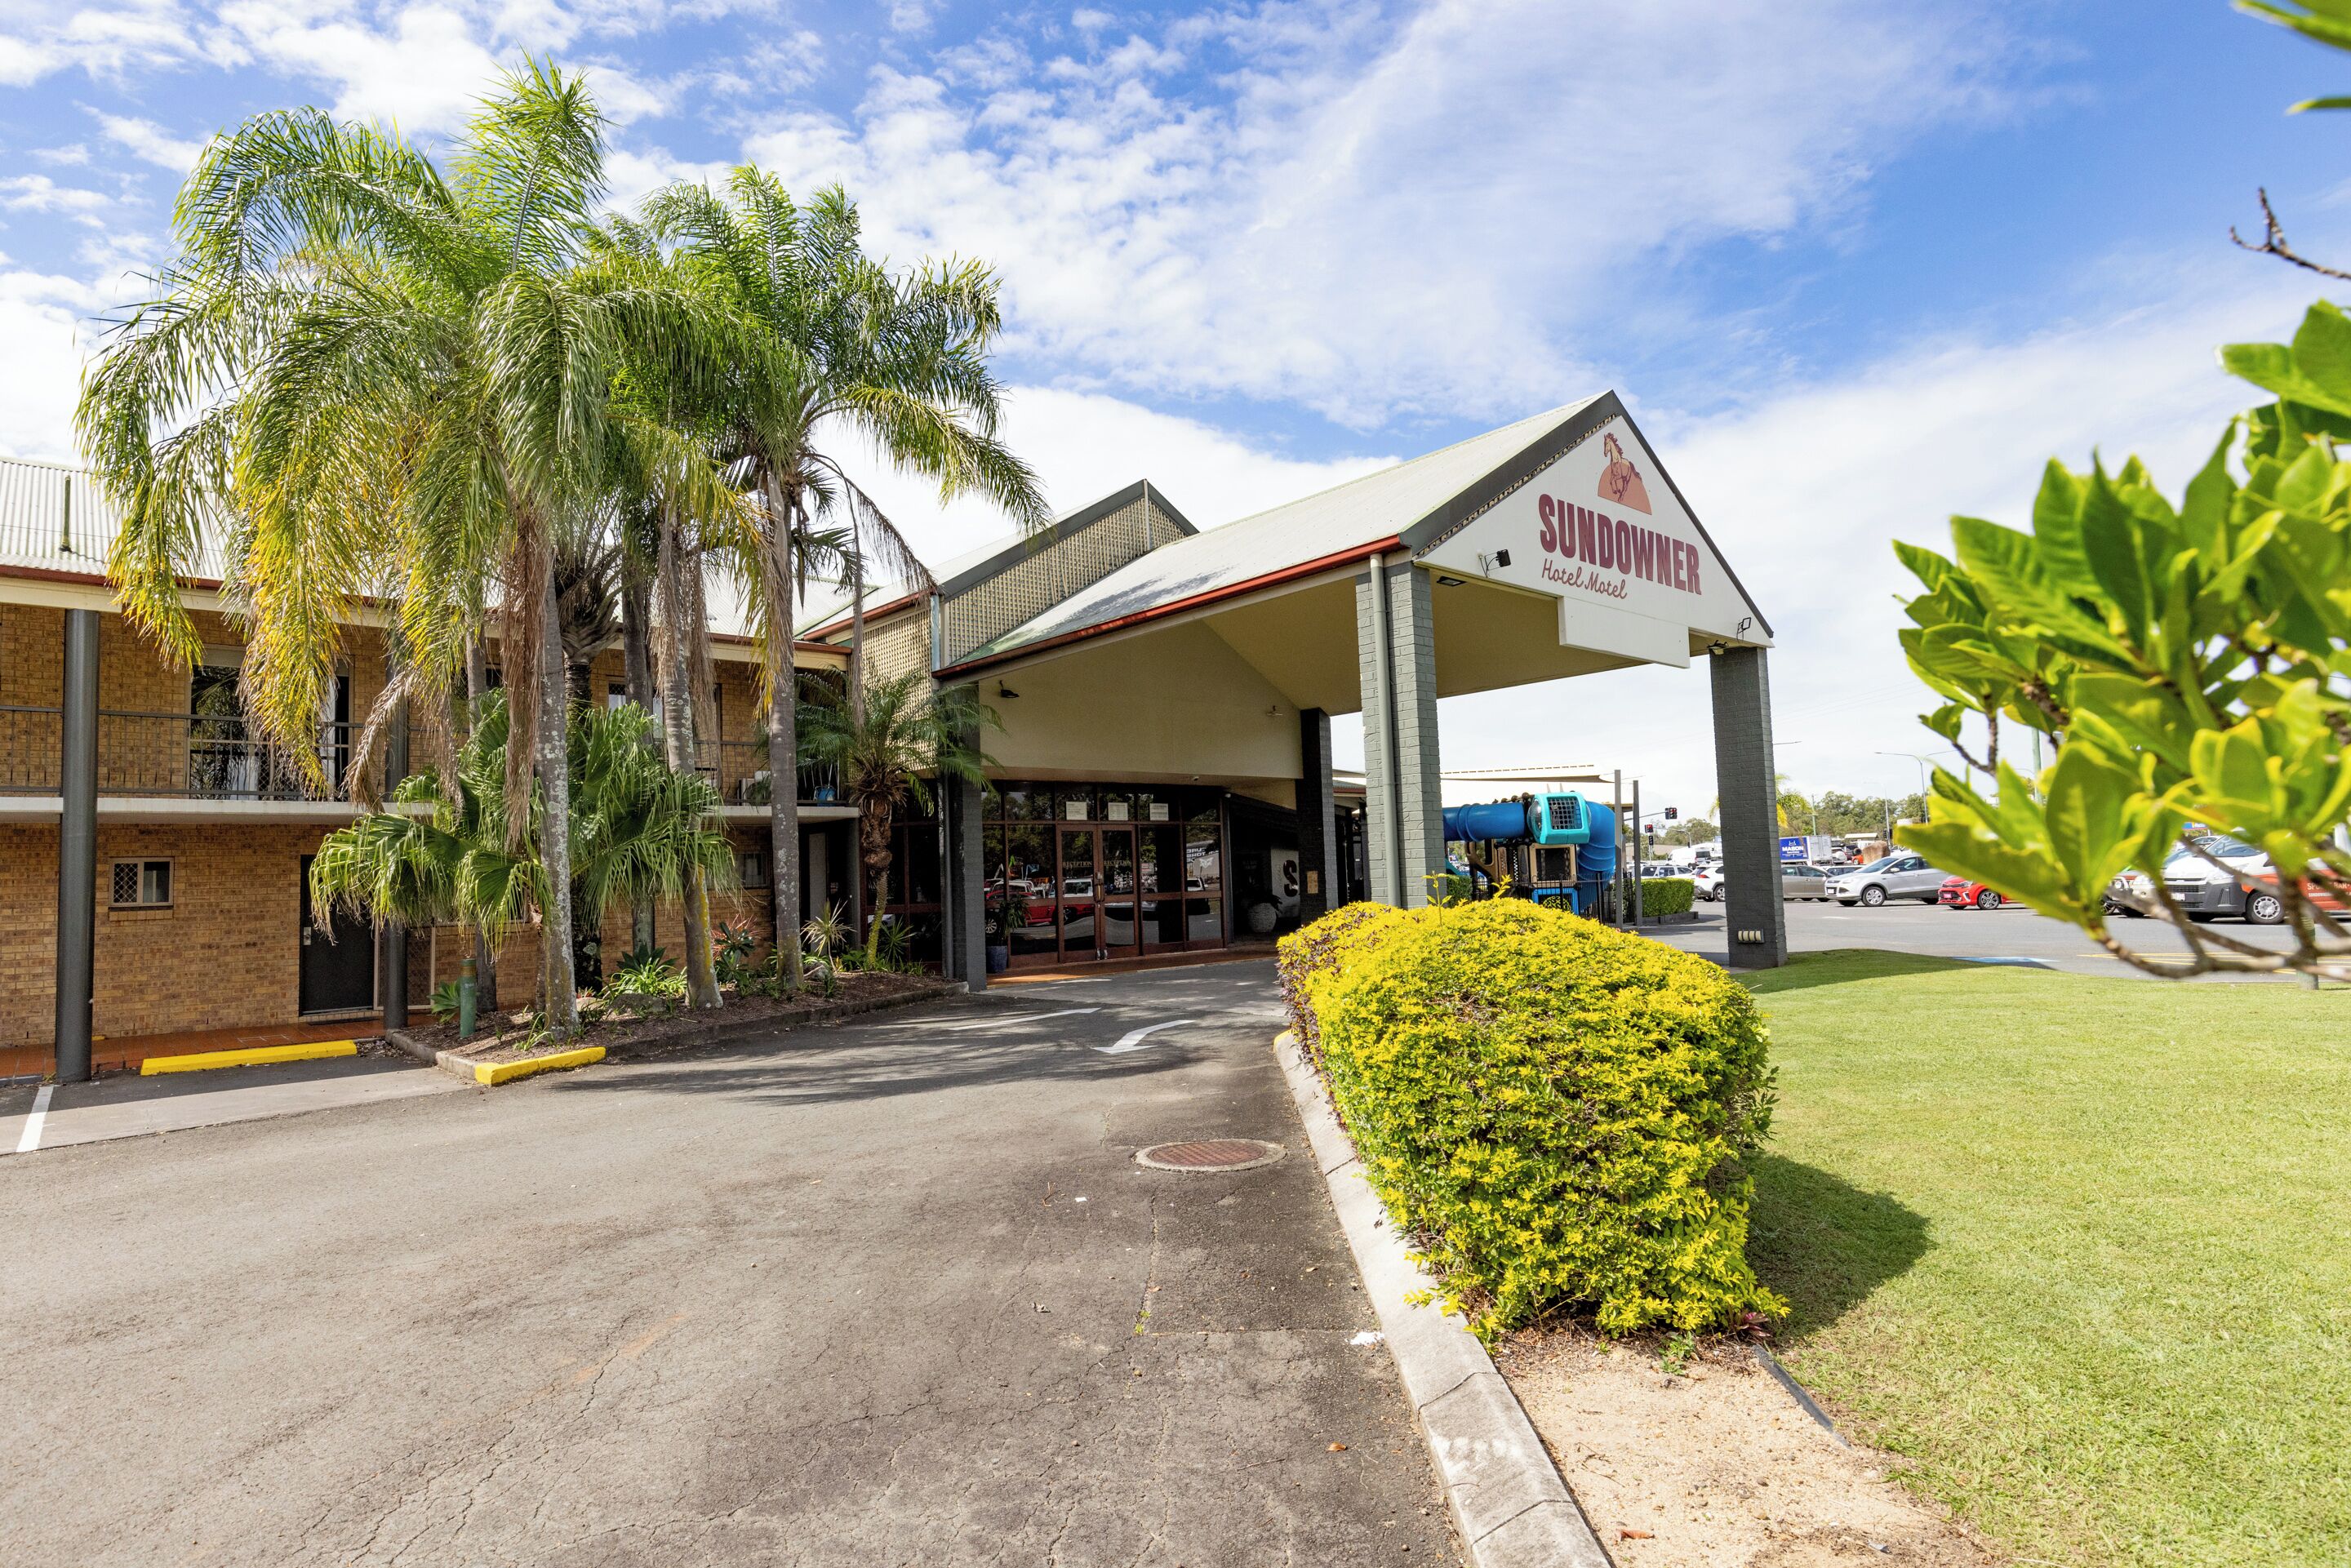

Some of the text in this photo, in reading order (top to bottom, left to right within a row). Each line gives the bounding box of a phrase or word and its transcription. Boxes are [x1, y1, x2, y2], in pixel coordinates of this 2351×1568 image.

[1539, 494, 1702, 596] SUNDOWNER
[1541, 558, 1628, 600] Hotel Motel
